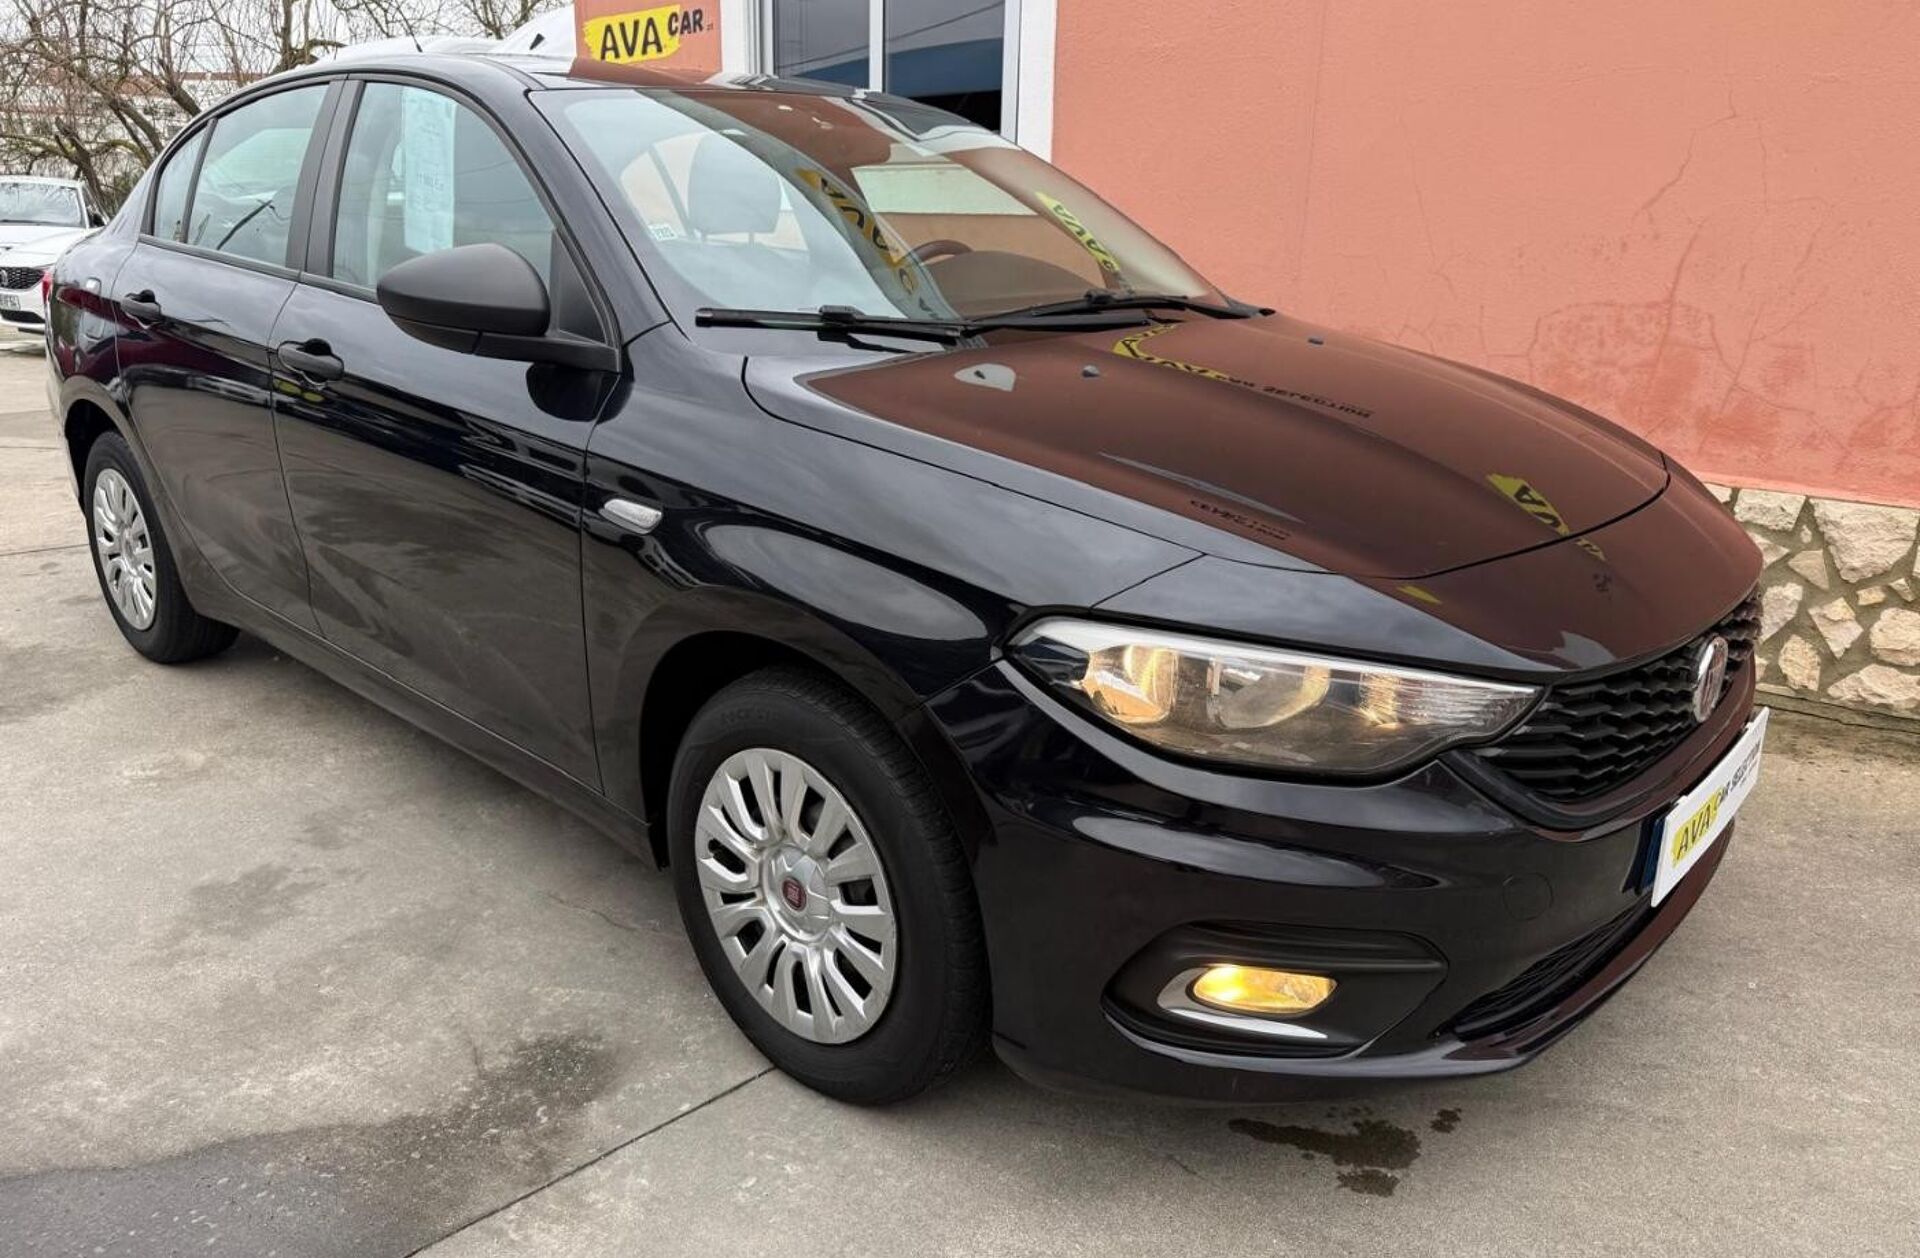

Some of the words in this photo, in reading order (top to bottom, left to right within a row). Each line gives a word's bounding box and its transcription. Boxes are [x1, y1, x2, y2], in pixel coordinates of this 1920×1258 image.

[601, 17, 662, 60] AVA
[668, 9, 704, 36] CAR
[1677, 804, 1711, 859] AVA
